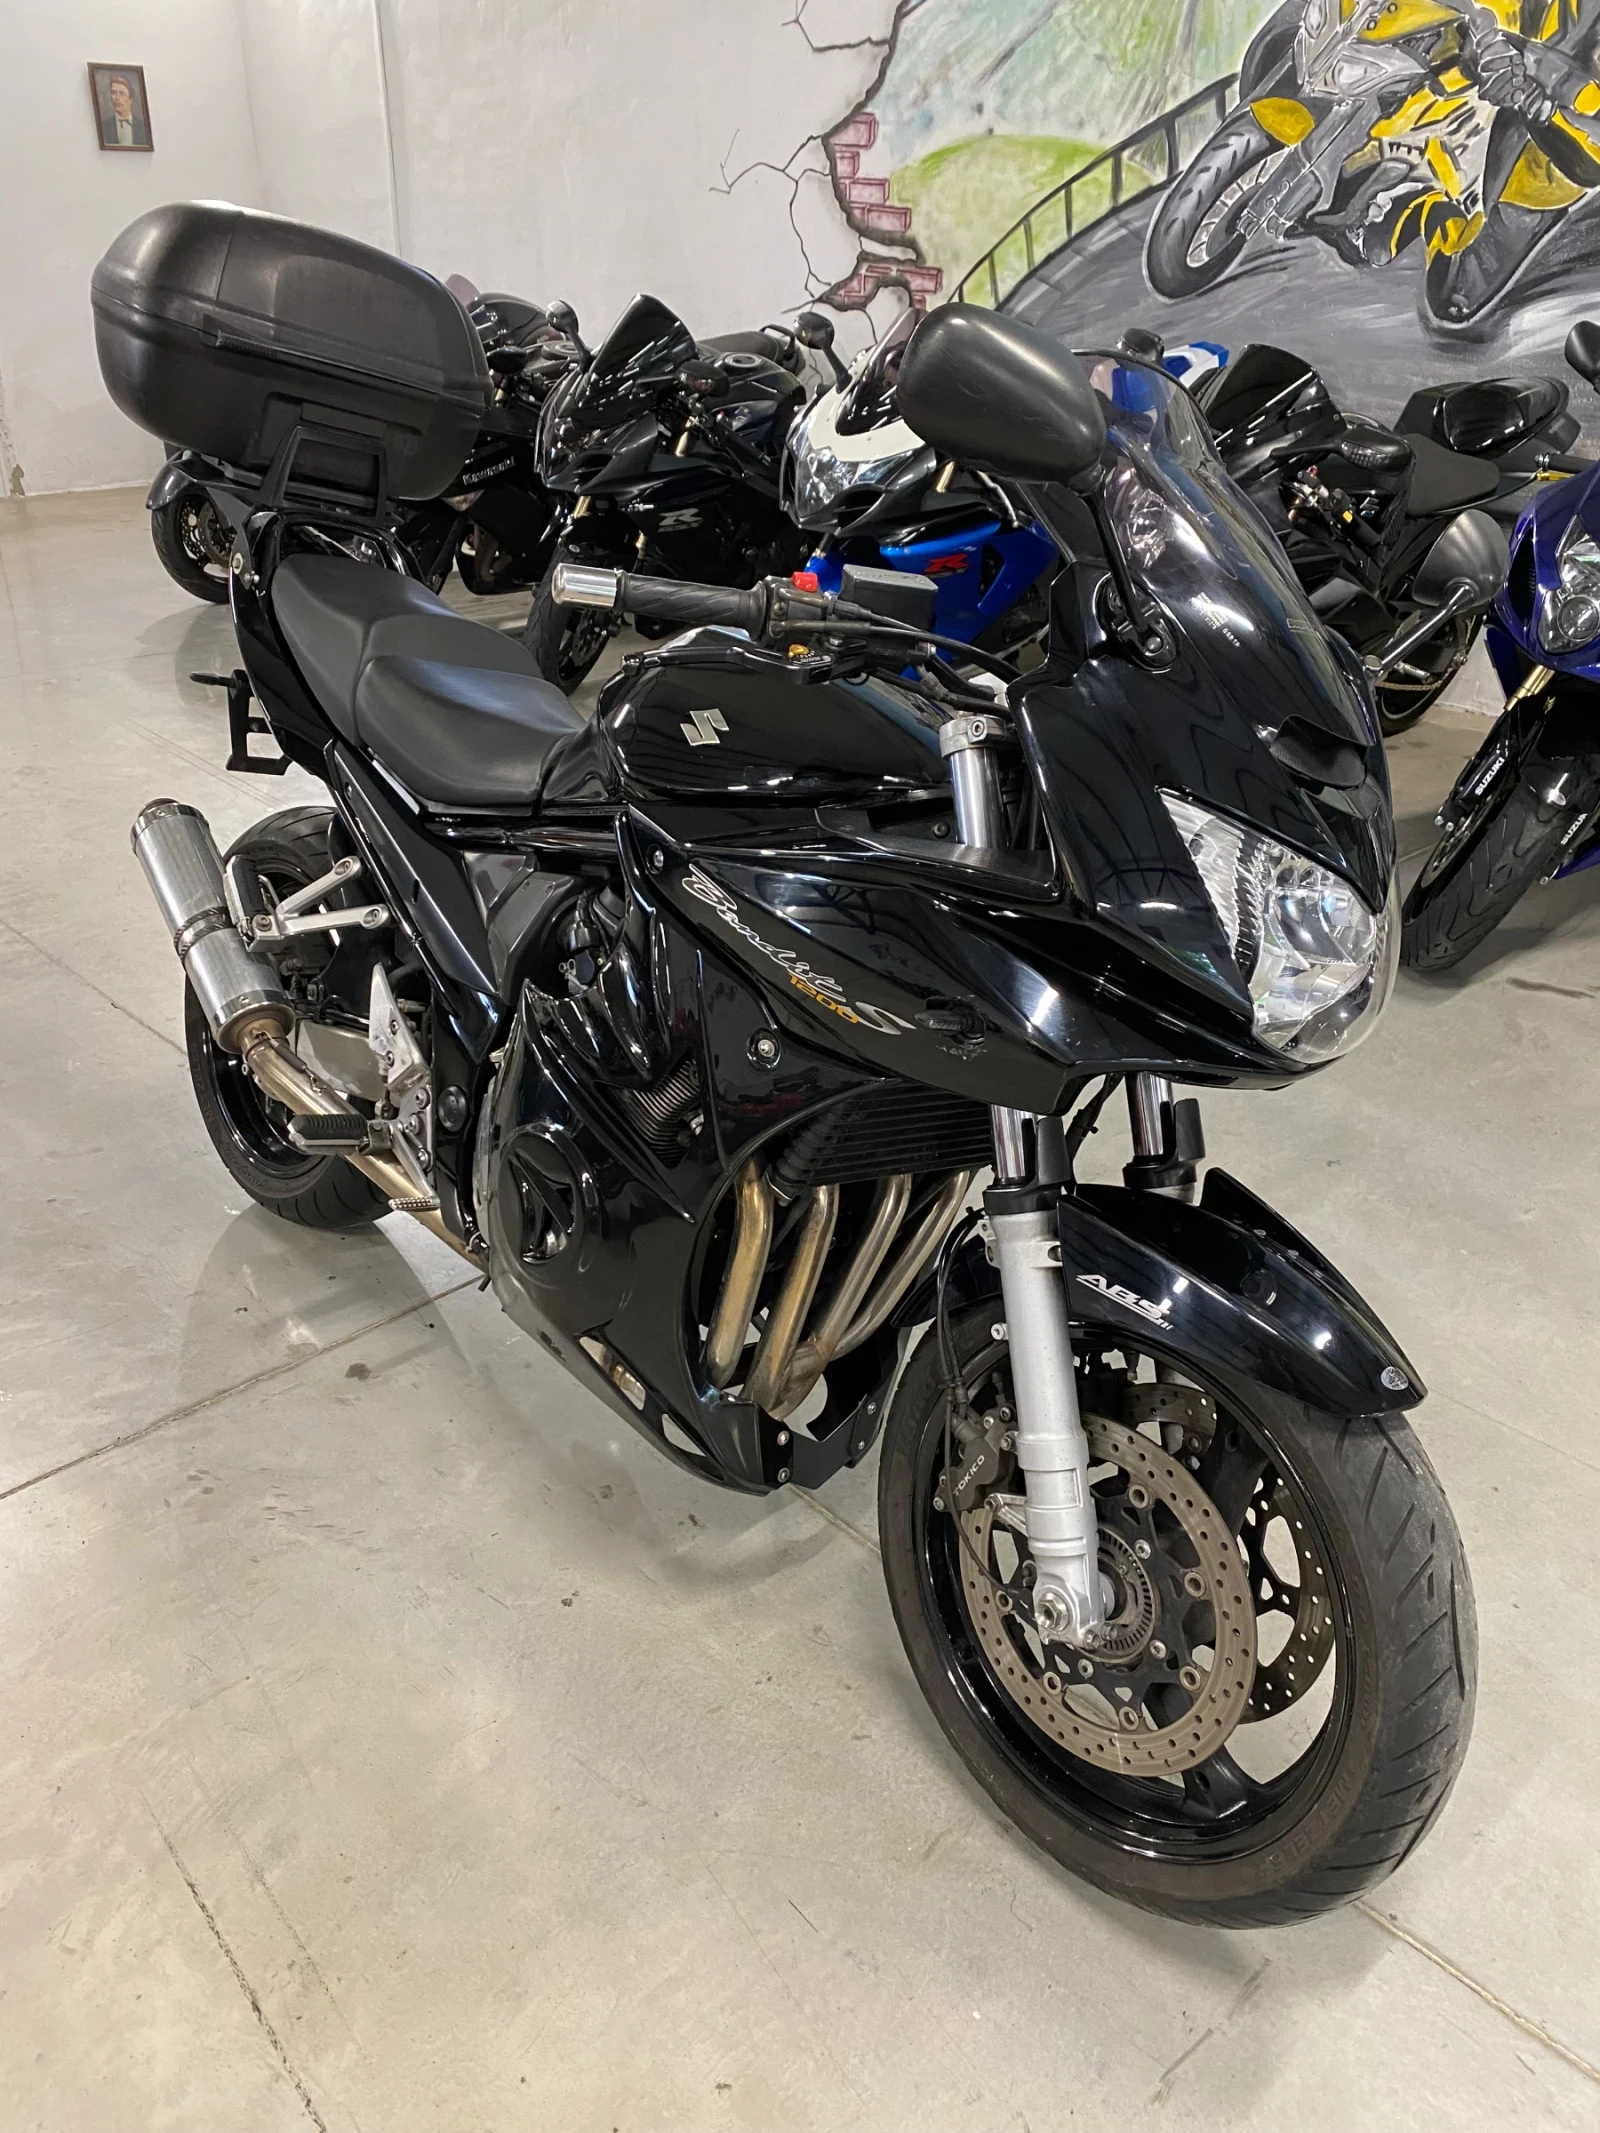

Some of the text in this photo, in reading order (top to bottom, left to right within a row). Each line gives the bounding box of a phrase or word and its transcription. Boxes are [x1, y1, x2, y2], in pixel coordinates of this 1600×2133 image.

[462, 455, 516, 486] Kawasaki
[1474, 756, 1505, 796] SUZUKI
[682, 863, 847, 1003] Bandit
[788, 972, 859, 1025] 1200
[1075, 1274, 1171, 1320] ABS
[952, 1454, 985, 1497] TOKICO
